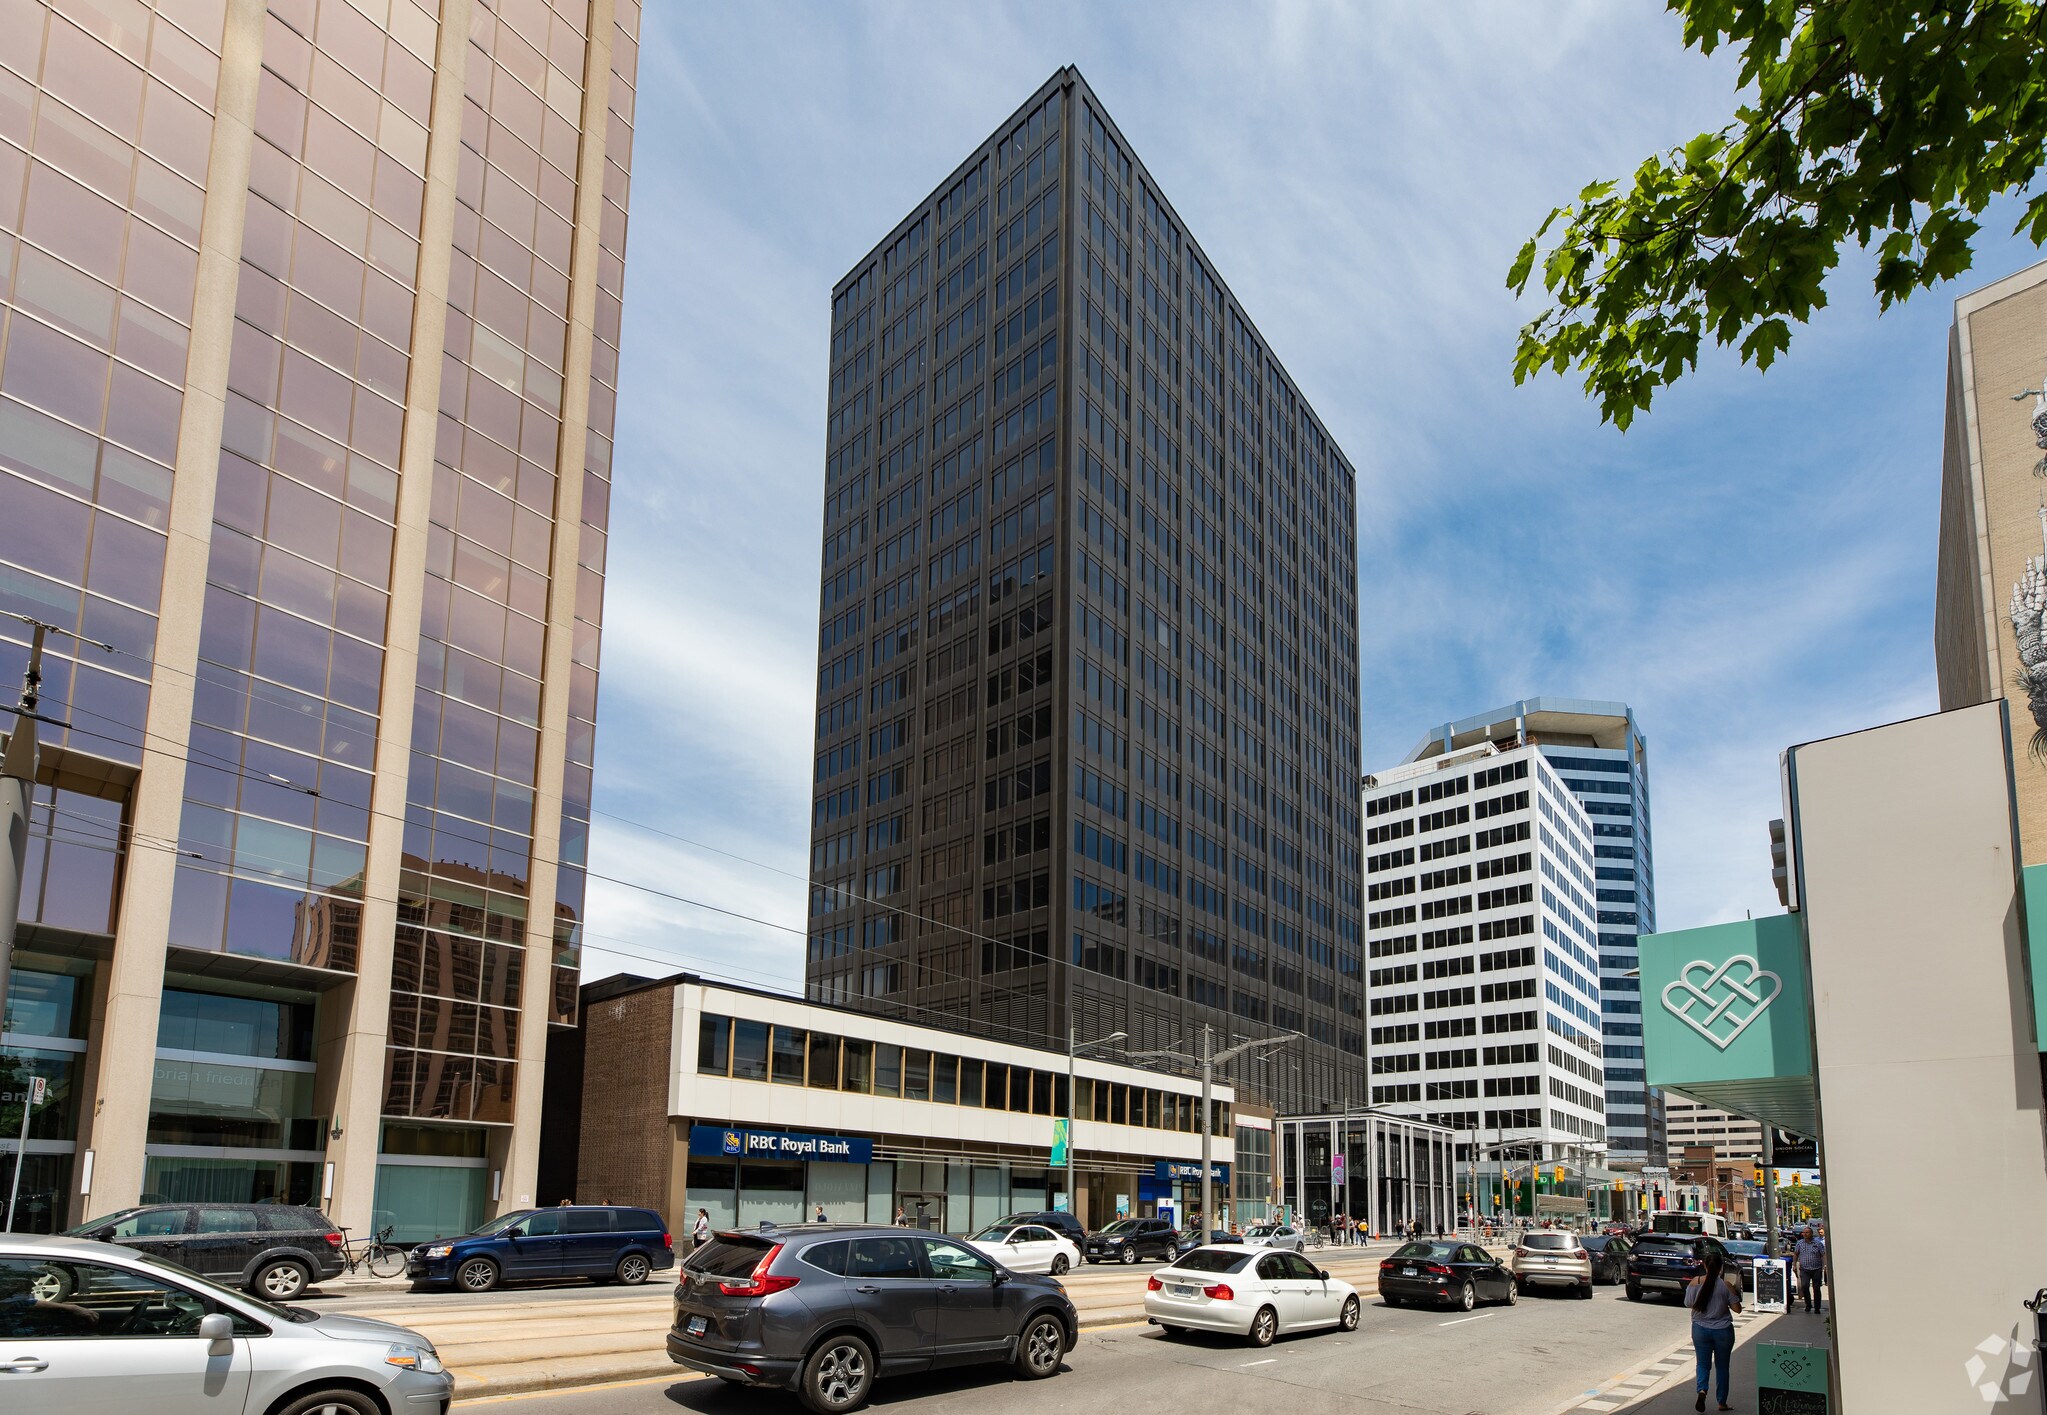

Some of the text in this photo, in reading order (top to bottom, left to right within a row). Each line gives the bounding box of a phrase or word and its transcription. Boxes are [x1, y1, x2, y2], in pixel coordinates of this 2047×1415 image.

[154, 1066, 199, 1082] brian
[750, 1135, 850, 1155] RBC Royal Bank
[1179, 1166, 1191, 1175] RBC
[1771, 1349, 1795, 1364] MARY
[1773, 1373, 1812, 1388] KITCHEN
